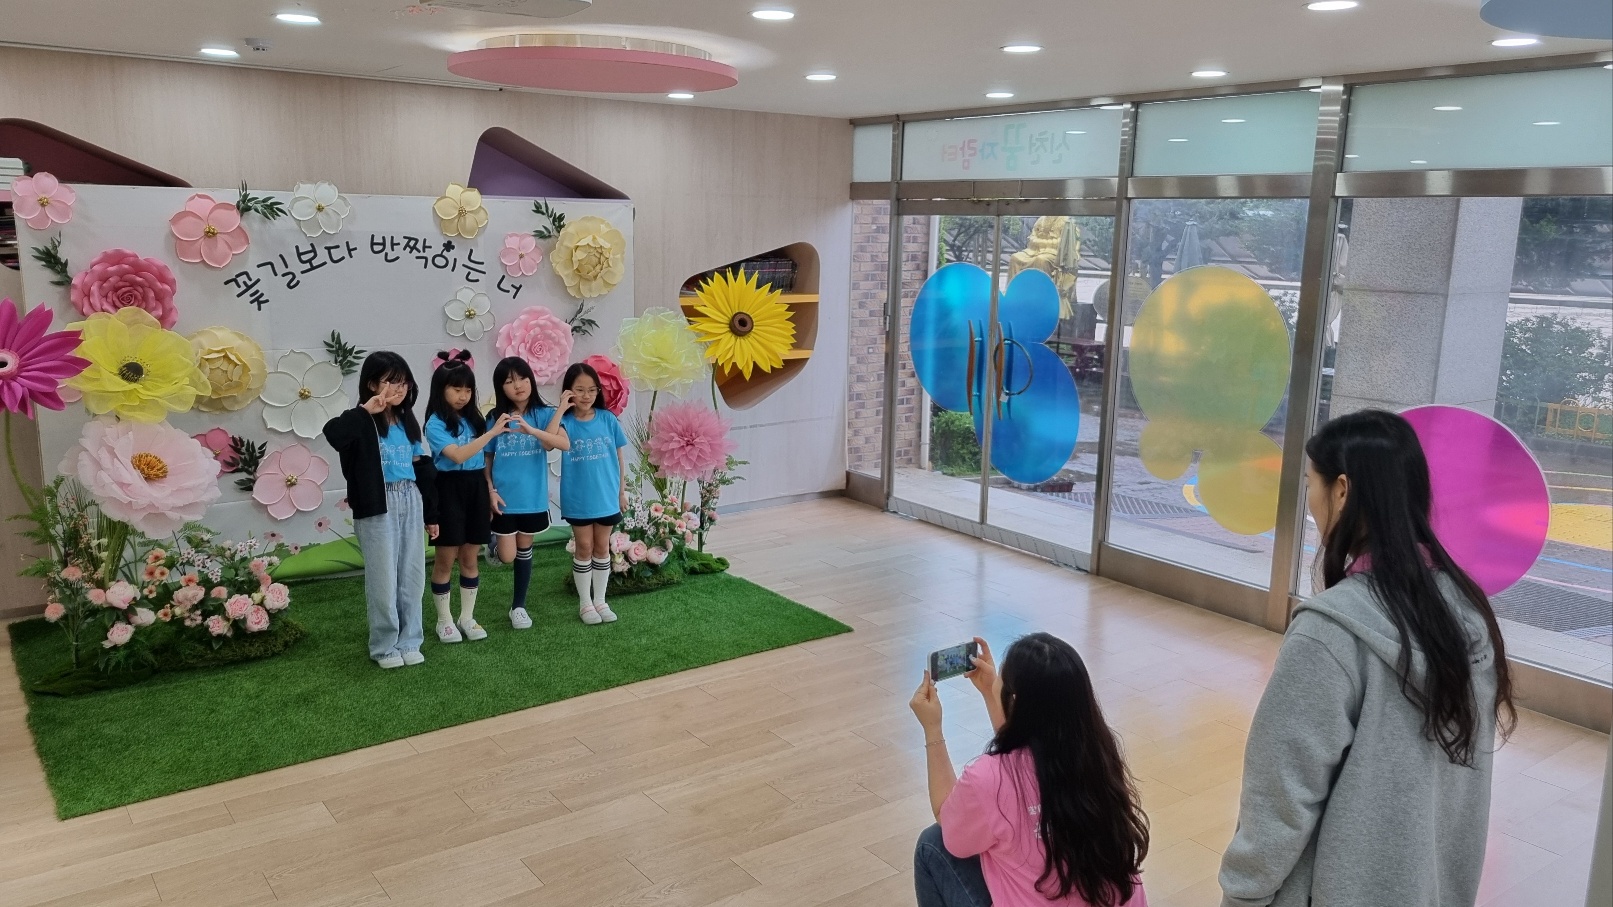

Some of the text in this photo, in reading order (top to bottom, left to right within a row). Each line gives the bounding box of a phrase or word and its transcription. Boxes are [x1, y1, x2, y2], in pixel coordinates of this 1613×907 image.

[224, 233, 523, 311] 꽃길보다 반짝이는 너
